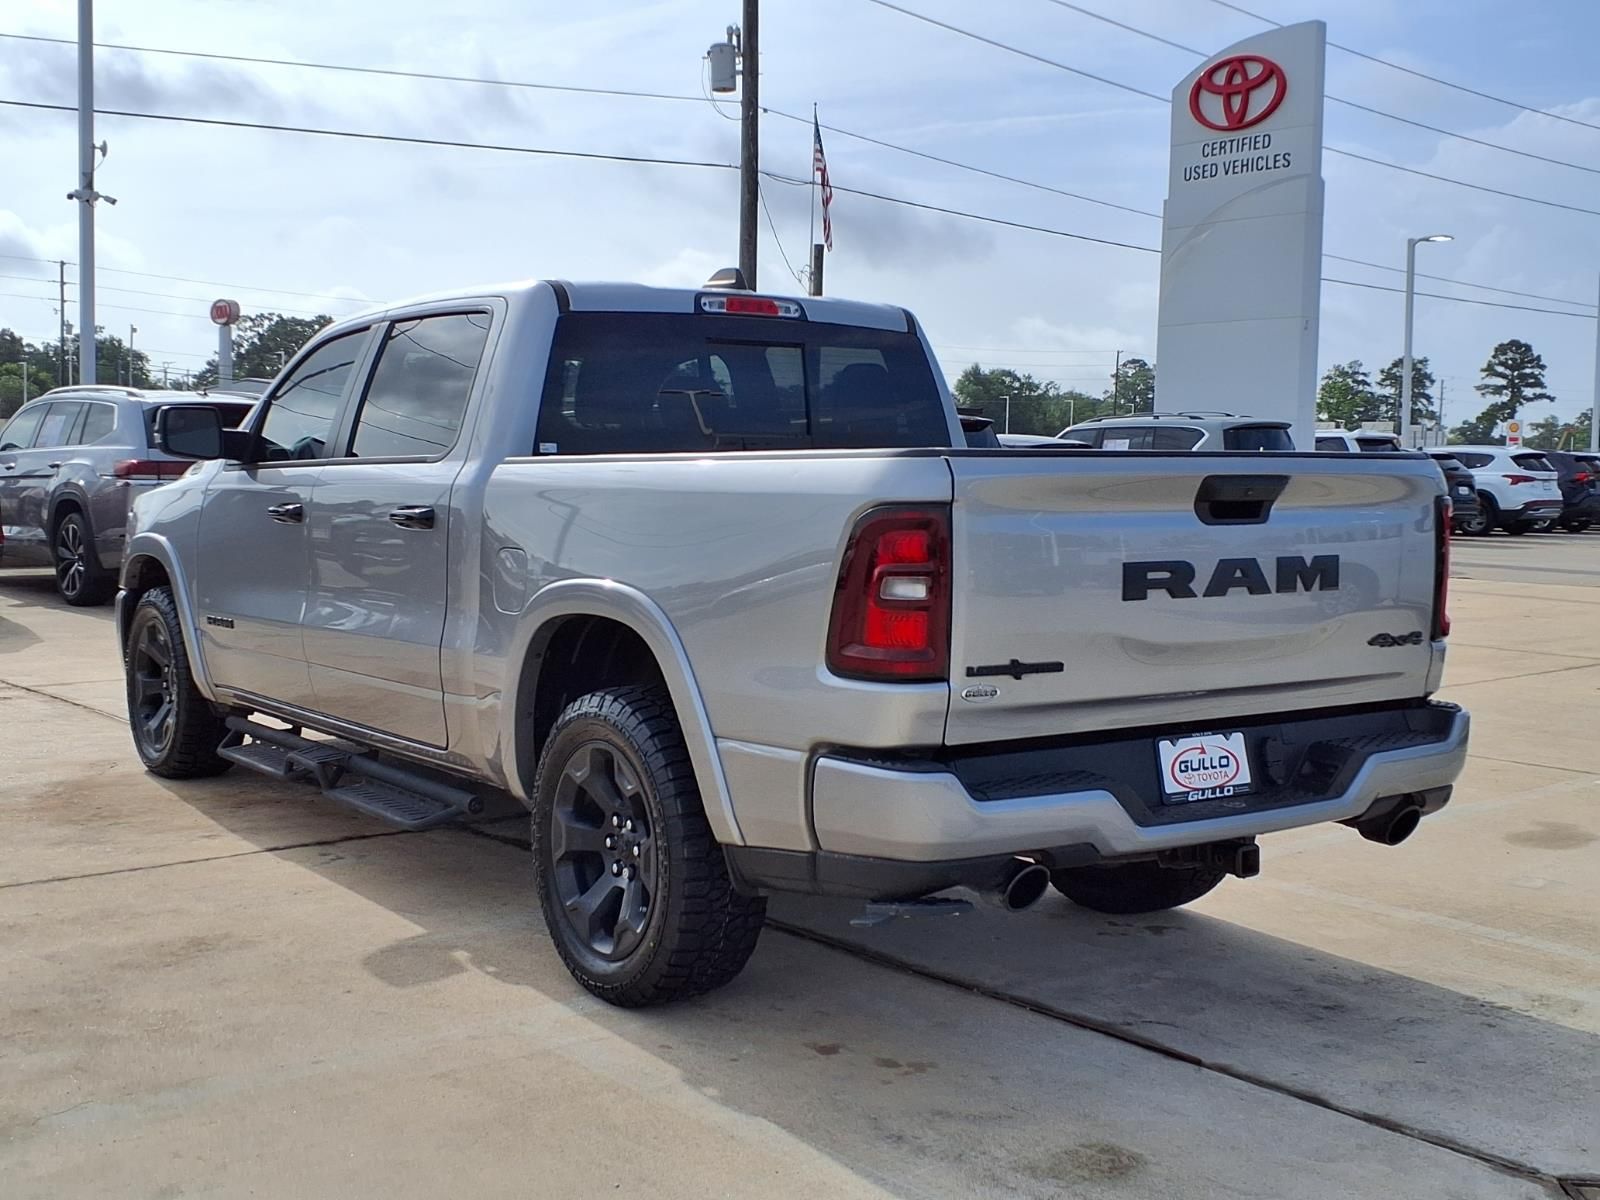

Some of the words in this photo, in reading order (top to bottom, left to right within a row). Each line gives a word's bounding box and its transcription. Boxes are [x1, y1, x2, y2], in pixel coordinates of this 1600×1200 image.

[1202, 133, 1271, 158] CERTIFIED
[1184, 163, 1218, 181] USED
[1223, 152, 1291, 176] VEHICLES
[1122, 554, 1340, 601] RAM
[1179, 755, 1230, 773] GULLO
[1197, 770, 1230, 782] TOYOTA
[1187, 786, 1234, 801] GULLO
